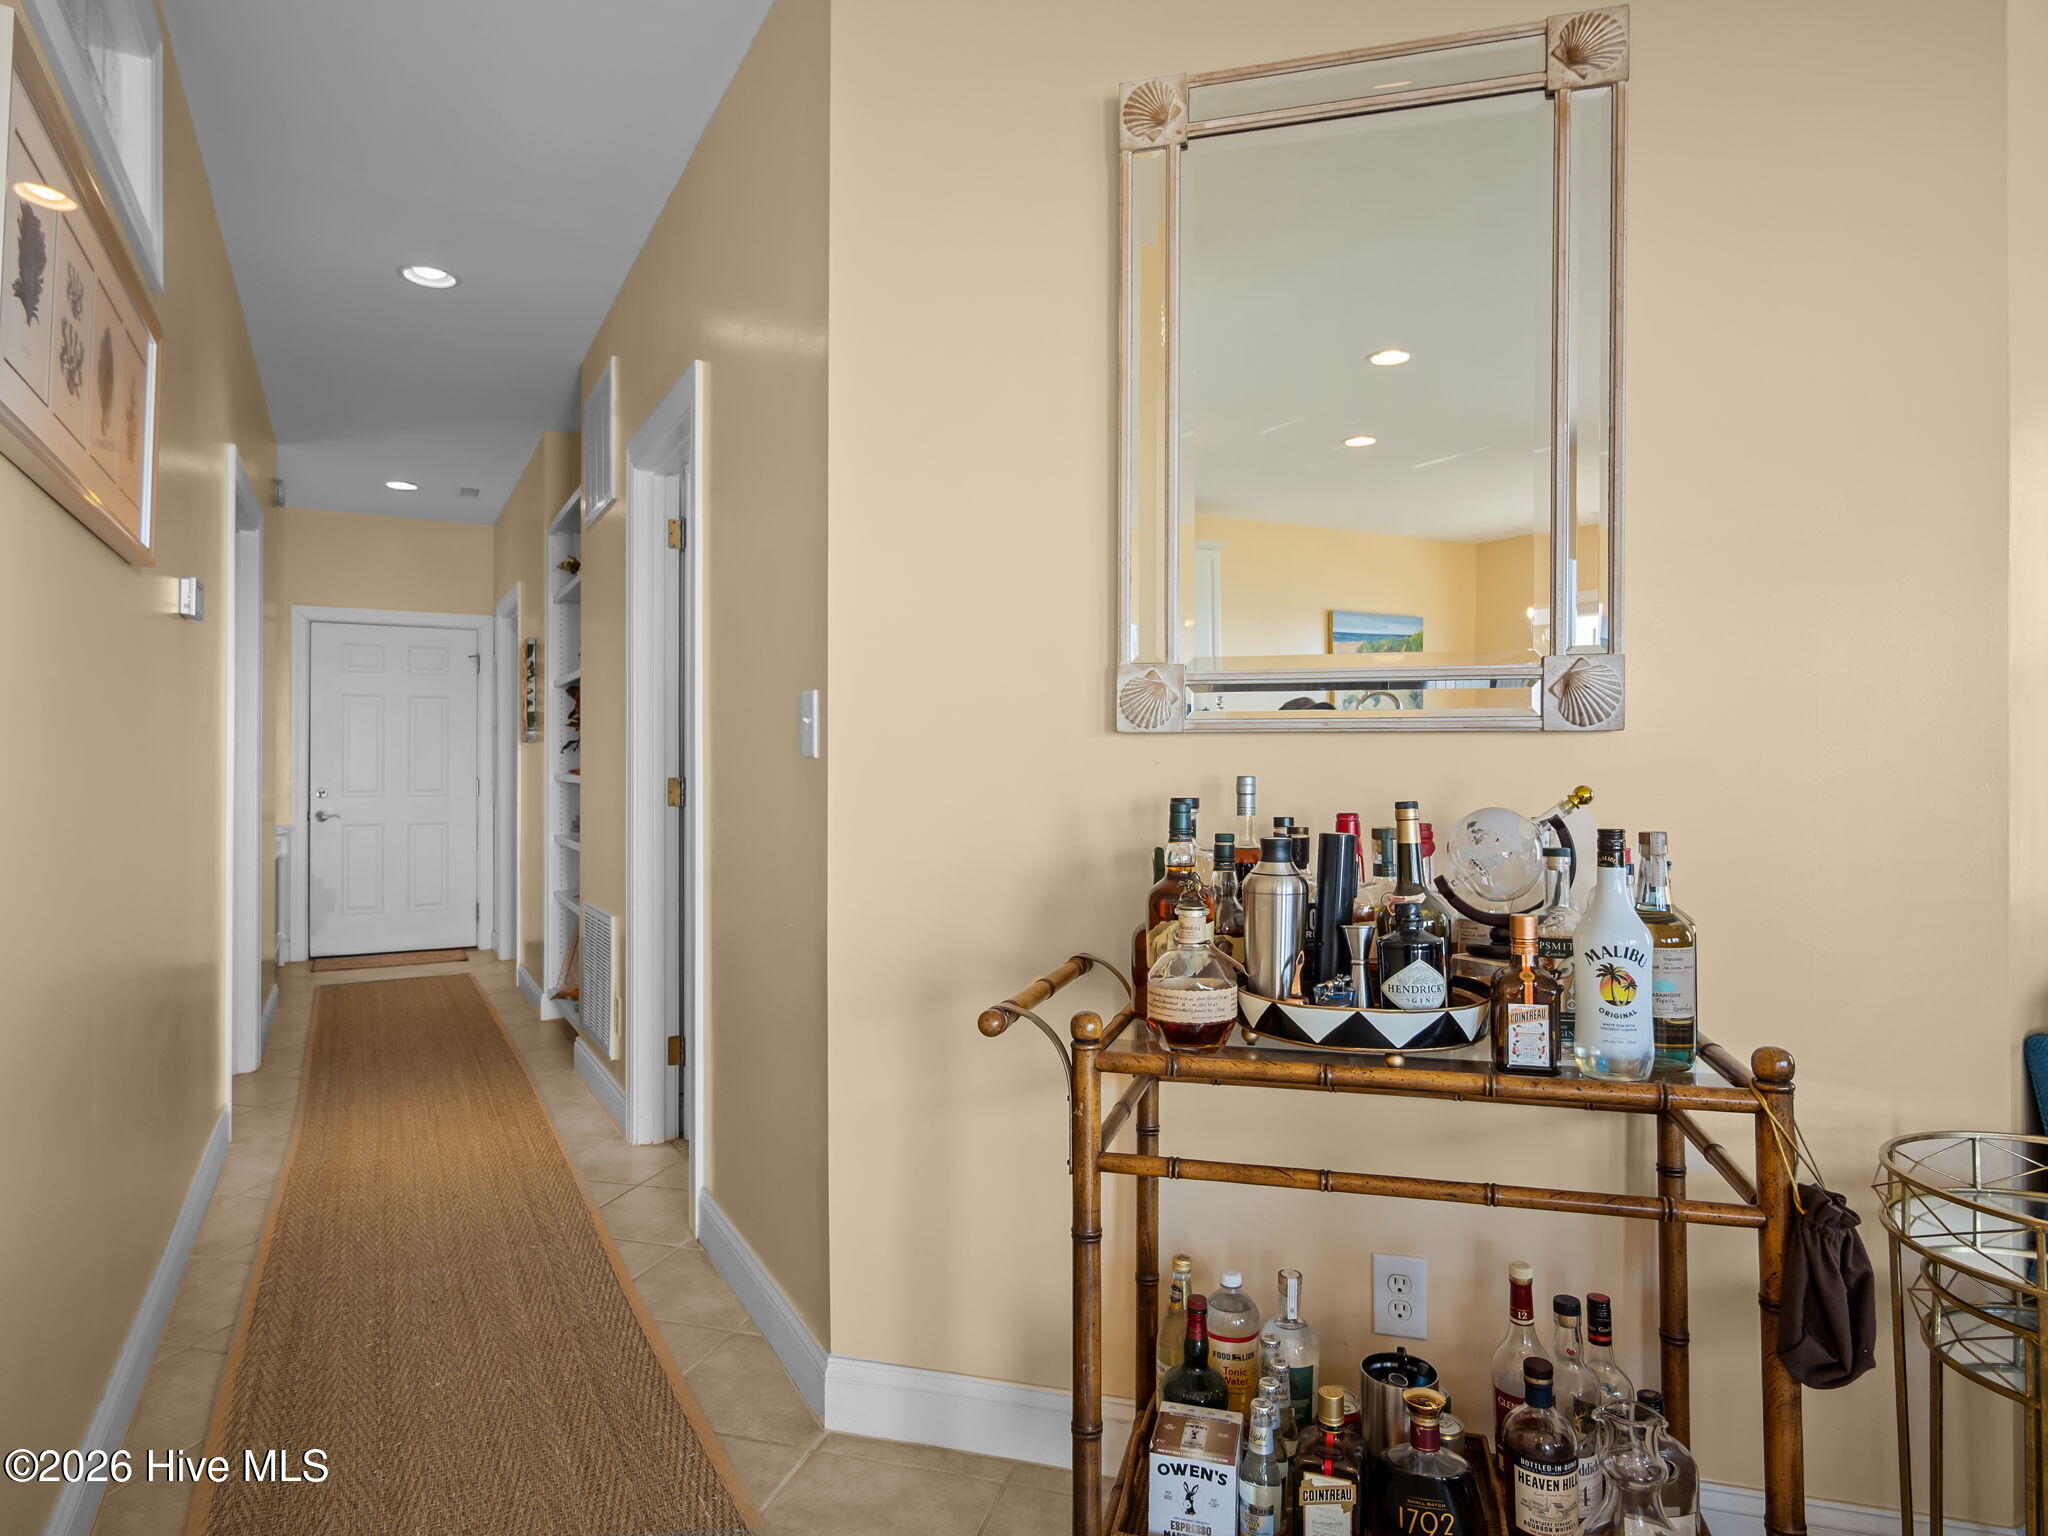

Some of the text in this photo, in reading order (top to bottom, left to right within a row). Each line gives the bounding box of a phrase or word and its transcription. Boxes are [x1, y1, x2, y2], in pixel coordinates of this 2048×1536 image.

[1539, 941, 1574, 951] PSMIT
[1583, 945, 1648, 968] MALIBU
[1510, 1009, 1546, 1023] COINTREAU
[1598, 1007, 1638, 1019] ORIGINAL
[1517, 1311, 1528, 1320] 12
[1212, 1351, 1231, 1360] FOOD
[1223, 1366, 1248, 1376] Tonic
[1157, 1462, 1228, 1486] OWEN'S
[1518, 1470, 1560, 1492] HEAVEN
[1302, 1488, 1352, 1502] COINTREAU
[1170, 1520, 1212, 1536] ESPRESSO
[1399, 1506, 1455, 1536] 1792
[1523, 1519, 1553, 1533] BOURBON
